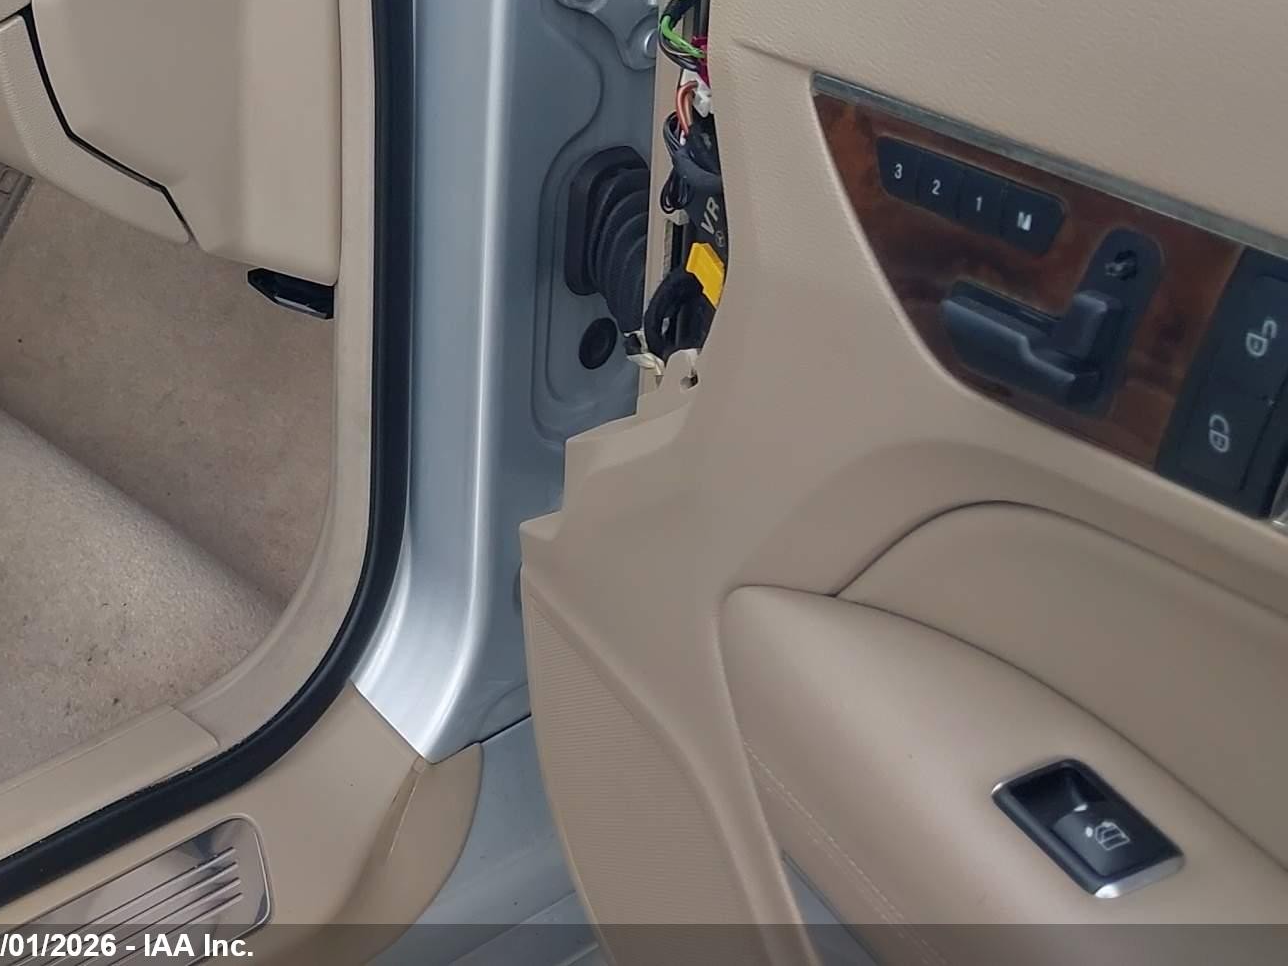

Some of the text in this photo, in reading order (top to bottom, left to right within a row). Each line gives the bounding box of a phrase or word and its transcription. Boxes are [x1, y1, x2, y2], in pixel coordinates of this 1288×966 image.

[894, 163, 903, 179] 3
[931, 179, 941, 195] 2
[976, 196, 983, 211] 1
[700, 195, 721, 236] VR
